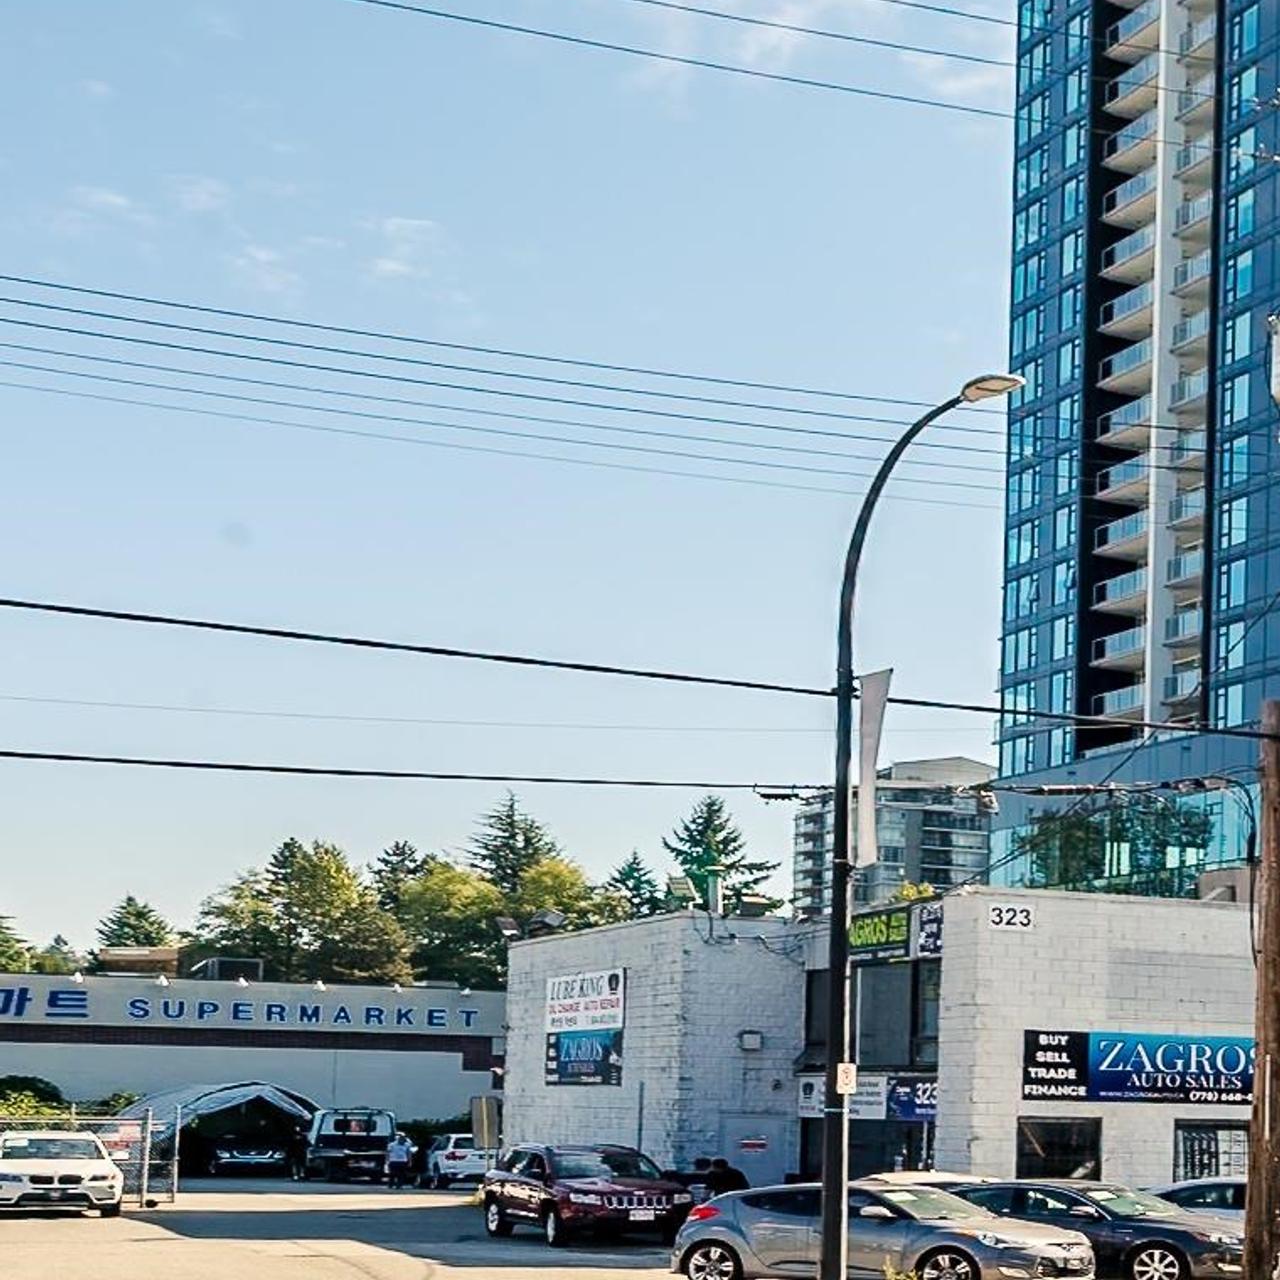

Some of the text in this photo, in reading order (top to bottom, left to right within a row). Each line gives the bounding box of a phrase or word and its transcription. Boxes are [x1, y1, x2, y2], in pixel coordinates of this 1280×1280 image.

[991, 907, 1031, 927] 323
[129, 998, 478, 1027] SUPERMARKET
[1039, 1034, 1069, 1046] BUY
[1035, 1051, 1071, 1063] SELL
[1028, 1067, 1077, 1079] TRADE
[1127, 1072, 1243, 1089] AUTO SALES
[1024, 1084, 1088, 1097] FINANCE
